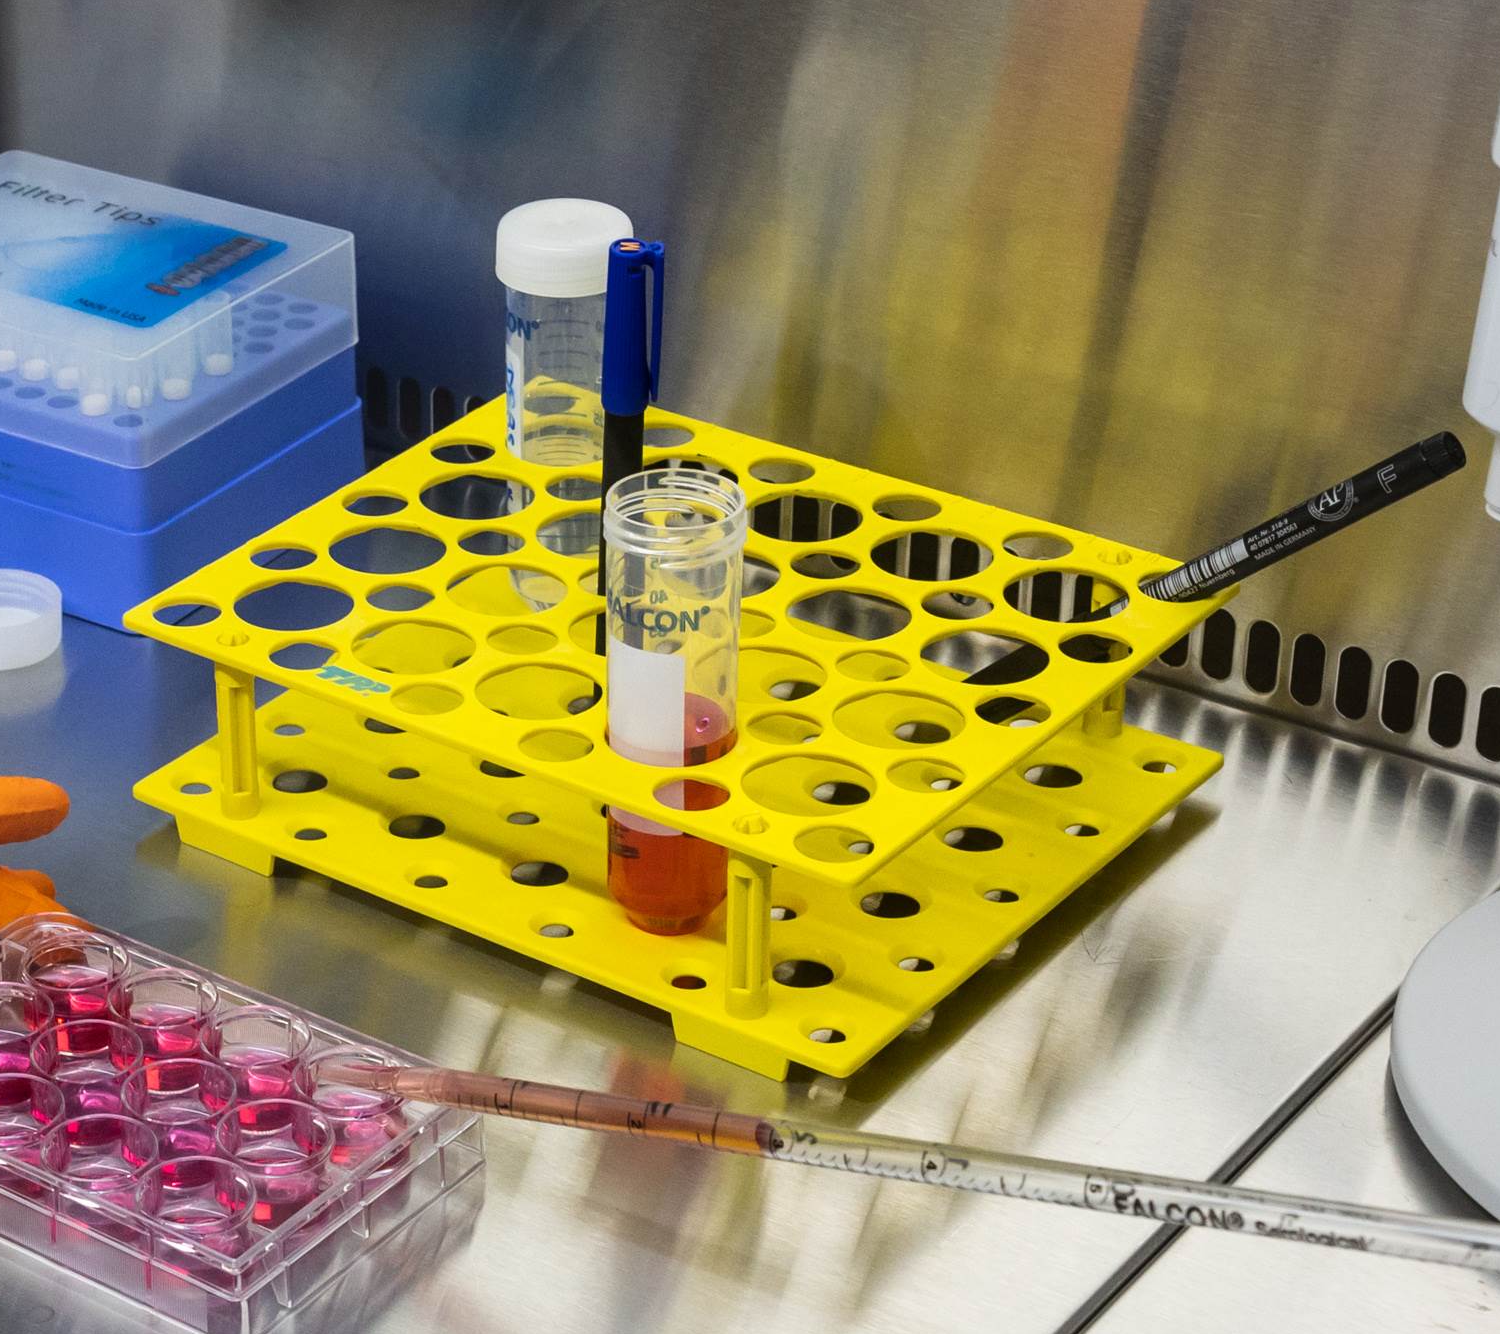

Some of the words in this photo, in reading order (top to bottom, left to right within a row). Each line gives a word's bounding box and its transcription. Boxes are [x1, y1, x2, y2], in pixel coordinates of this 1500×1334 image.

[90, 198, 163, 228] Tips
[1376, 463, 1398, 495] F
[1254, 546, 1276, 560] MADE
[1283, 526, 1317, 546] GERMANY
